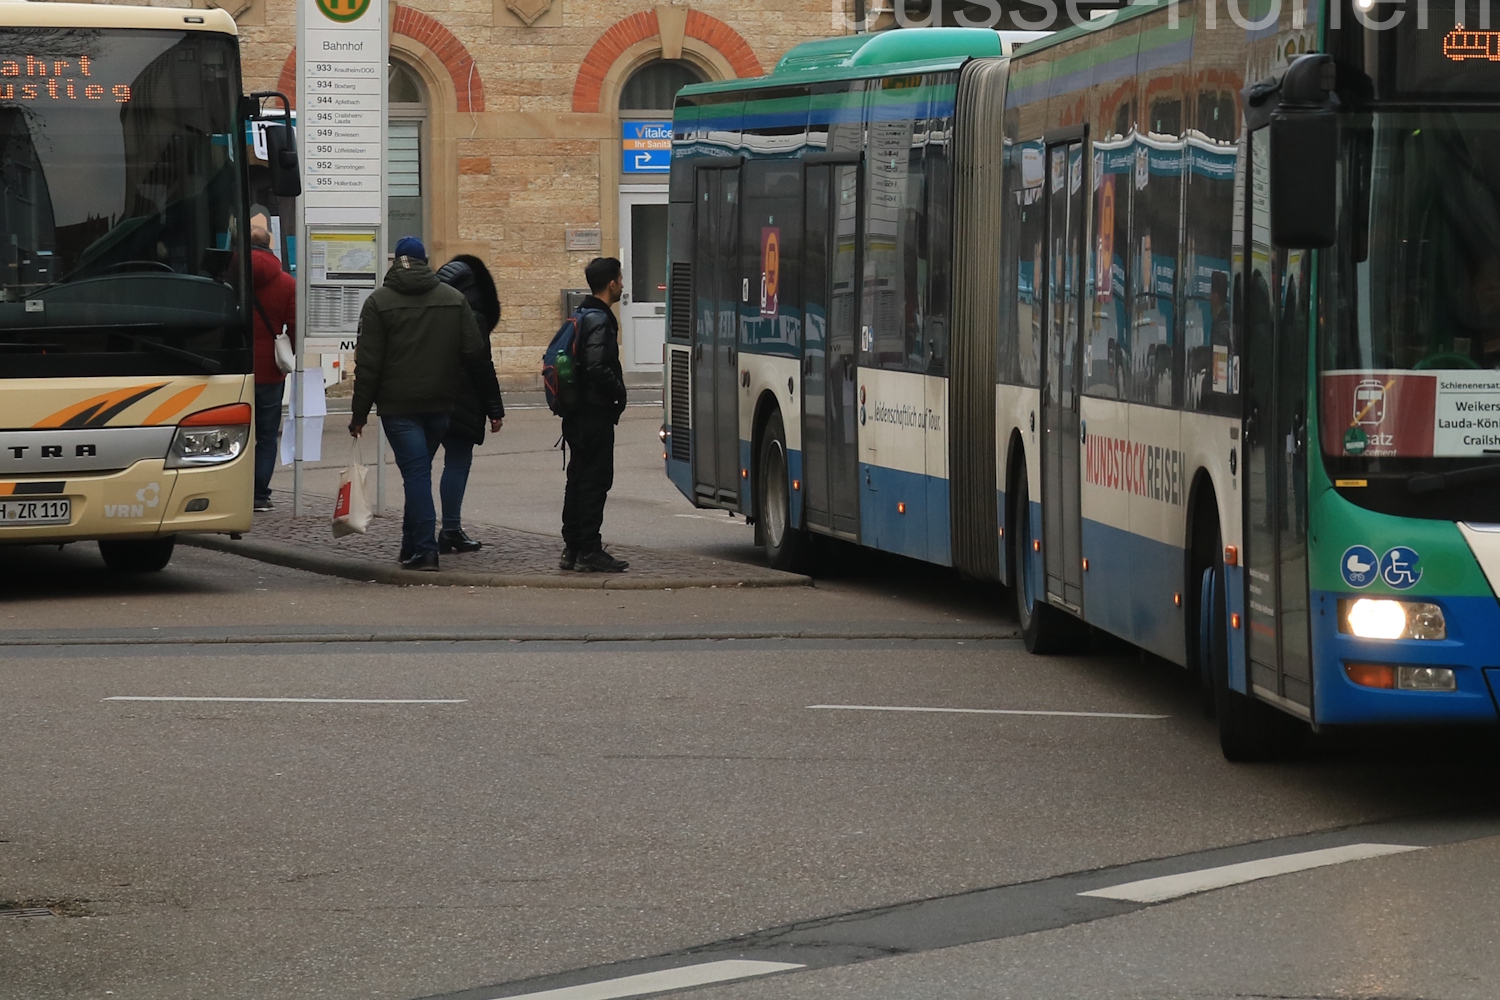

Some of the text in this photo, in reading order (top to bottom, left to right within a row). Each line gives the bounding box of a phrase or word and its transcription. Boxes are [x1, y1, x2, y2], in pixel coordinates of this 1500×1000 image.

[322, 41, 364, 51] Bahnhof
[0, 55, 91, 76] ahrt
[0, 79, 130, 102] ustieg
[1366, 432, 1393, 446] satz
[8, 444, 96, 458] TRA
[18, 503, 37, 518] ZR
[41, 502, 68, 518] 119
[104, 504, 144, 518] VRN
